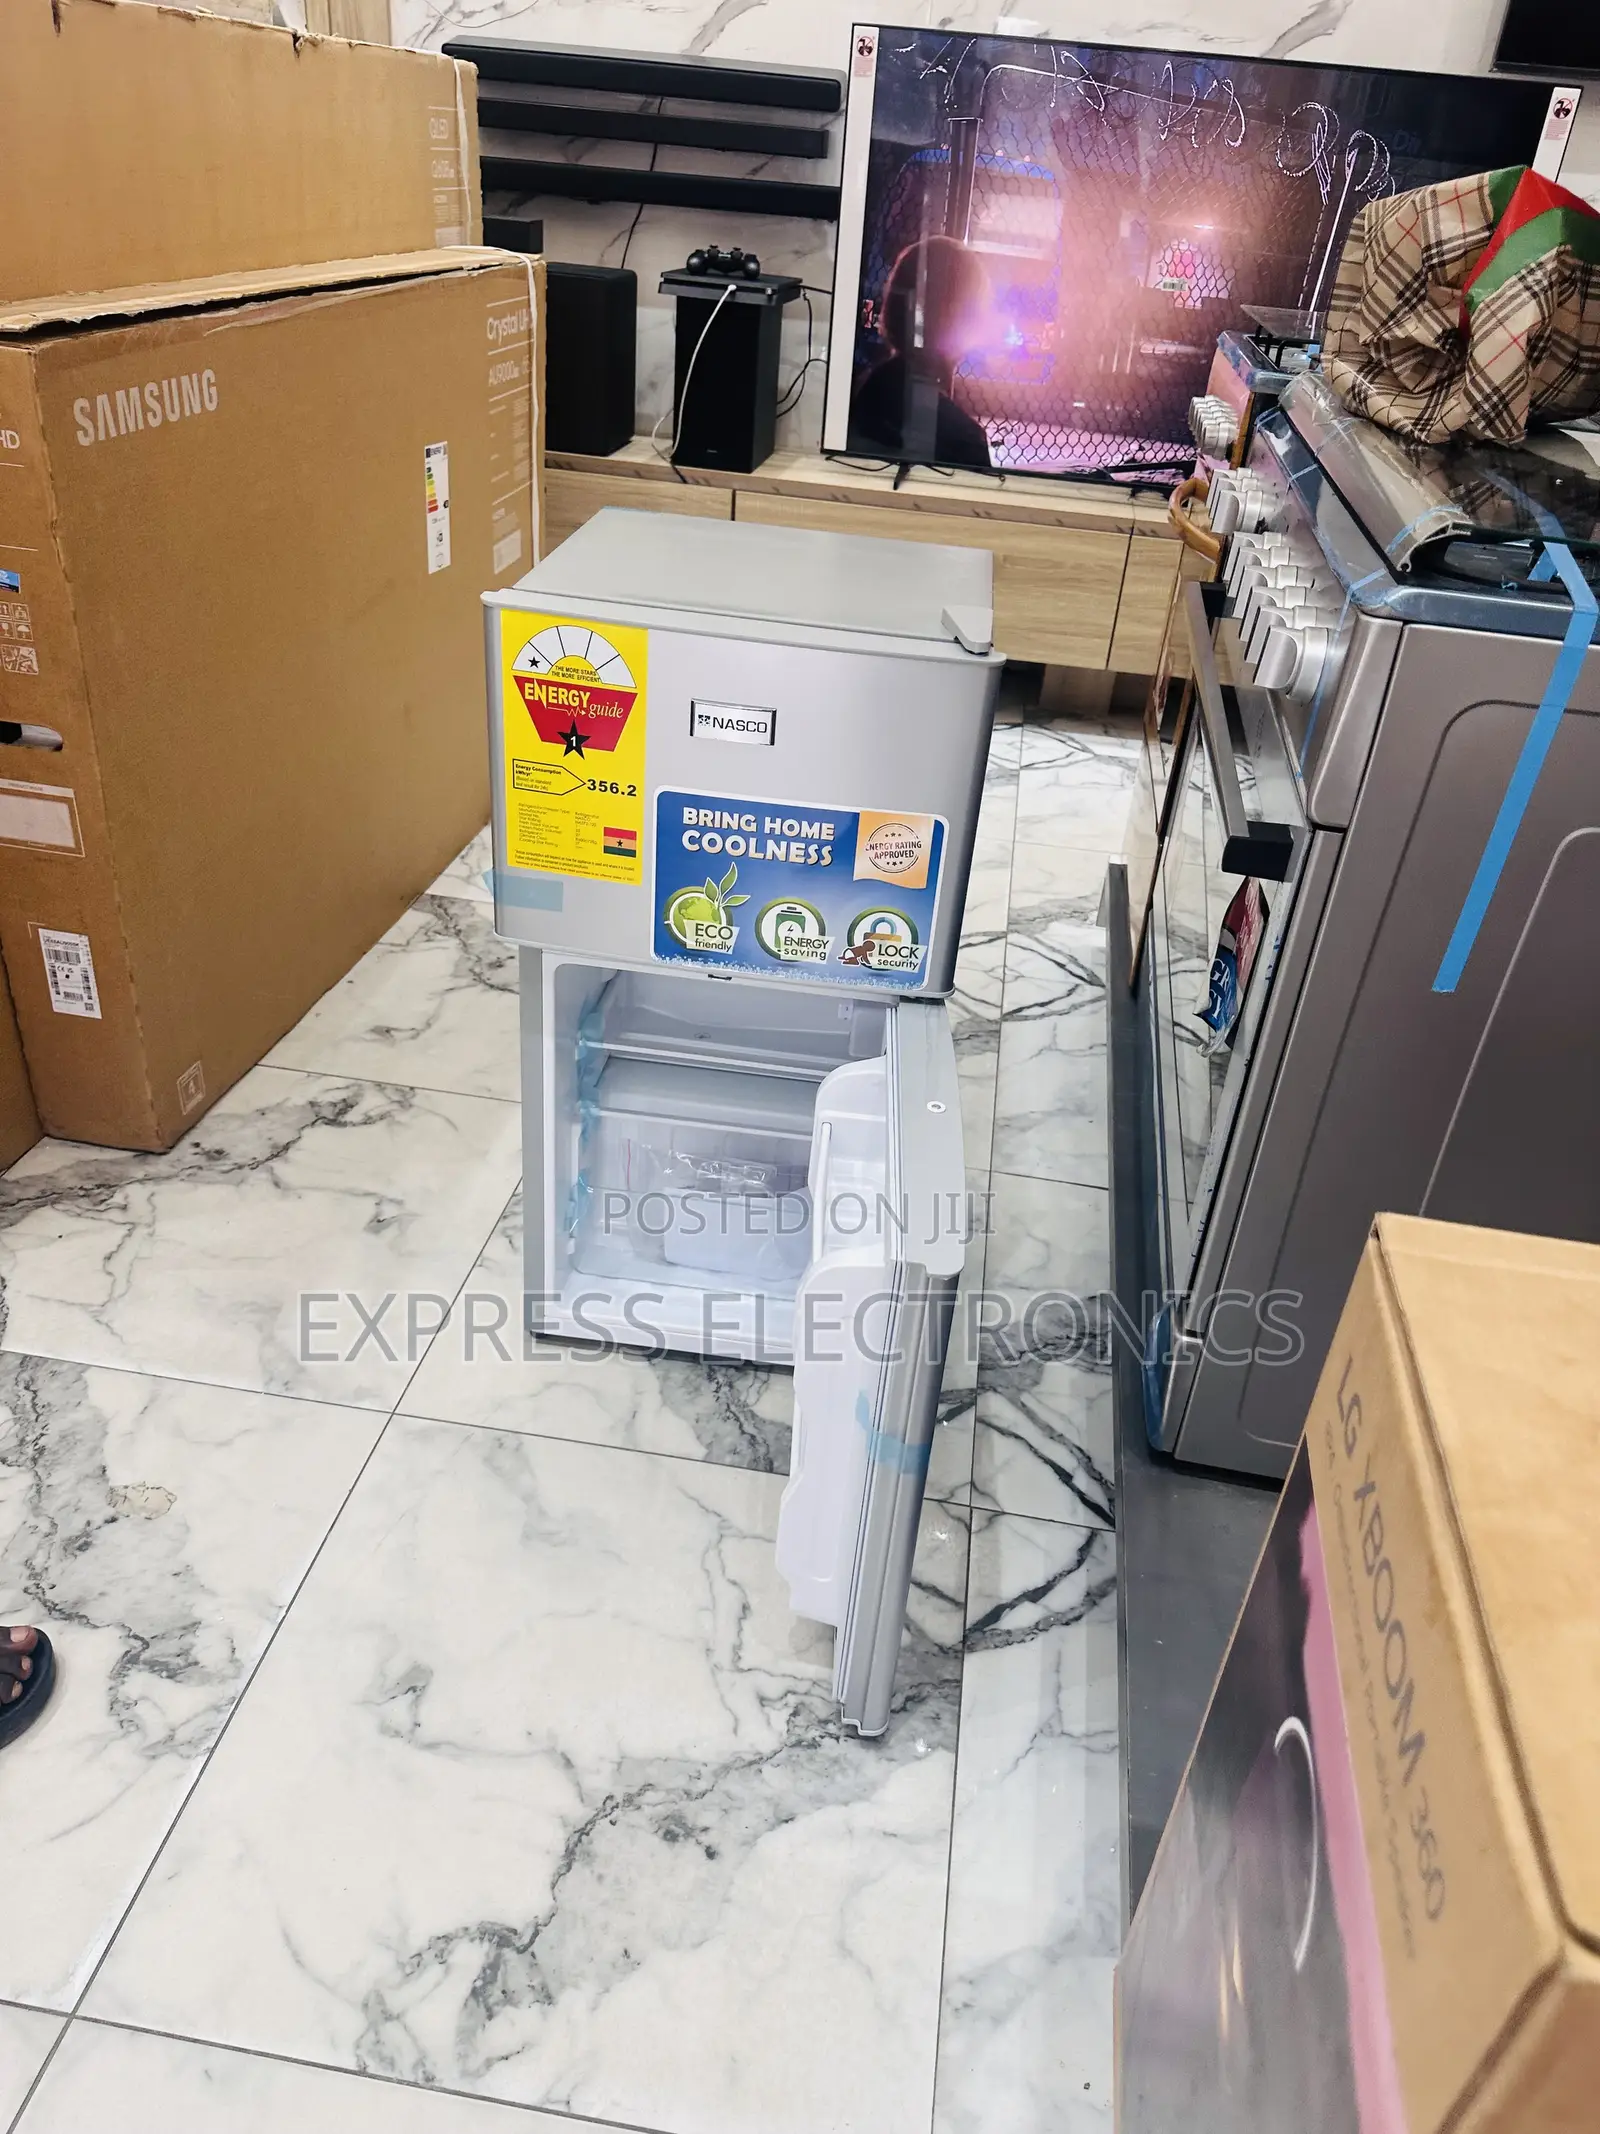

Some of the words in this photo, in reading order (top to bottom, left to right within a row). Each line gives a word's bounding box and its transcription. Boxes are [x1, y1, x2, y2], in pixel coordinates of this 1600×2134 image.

[72, 368, 220, 447] SAMSUNG
[561, 672, 575, 680] MORE
[576, 674, 600, 683] EFFICIENT
[565, 666, 579, 674] MORE
[524, 678, 591, 709] ENERGY
[588, 701, 623, 719] guide
[711, 715, 768, 734] NASCO
[570, 735, 577, 748] 1
[531, 766, 562, 775] Consumption
[587, 778, 637, 797] 356.2
[682, 806, 757, 833] BRING
[764, 816, 835, 841] HOME
[681, 829, 833, 867] COOLNESS
[894, 840, 922, 850] RATING
[873, 849, 915, 860] APPROVED
[694, 922, 734, 940] ECO
[694, 937, 733, 953] friendly
[783, 936, 830, 950] ENERGY
[877, 943, 920, 959] LOCK
[783, 947, 828, 961] saving
[877, 958, 919, 971] security
[1336, 1353, 1363, 1460] LG
[1352, 1450, 1427, 1788] XBOOM
[1409, 1784, 1446, 1923] 360
